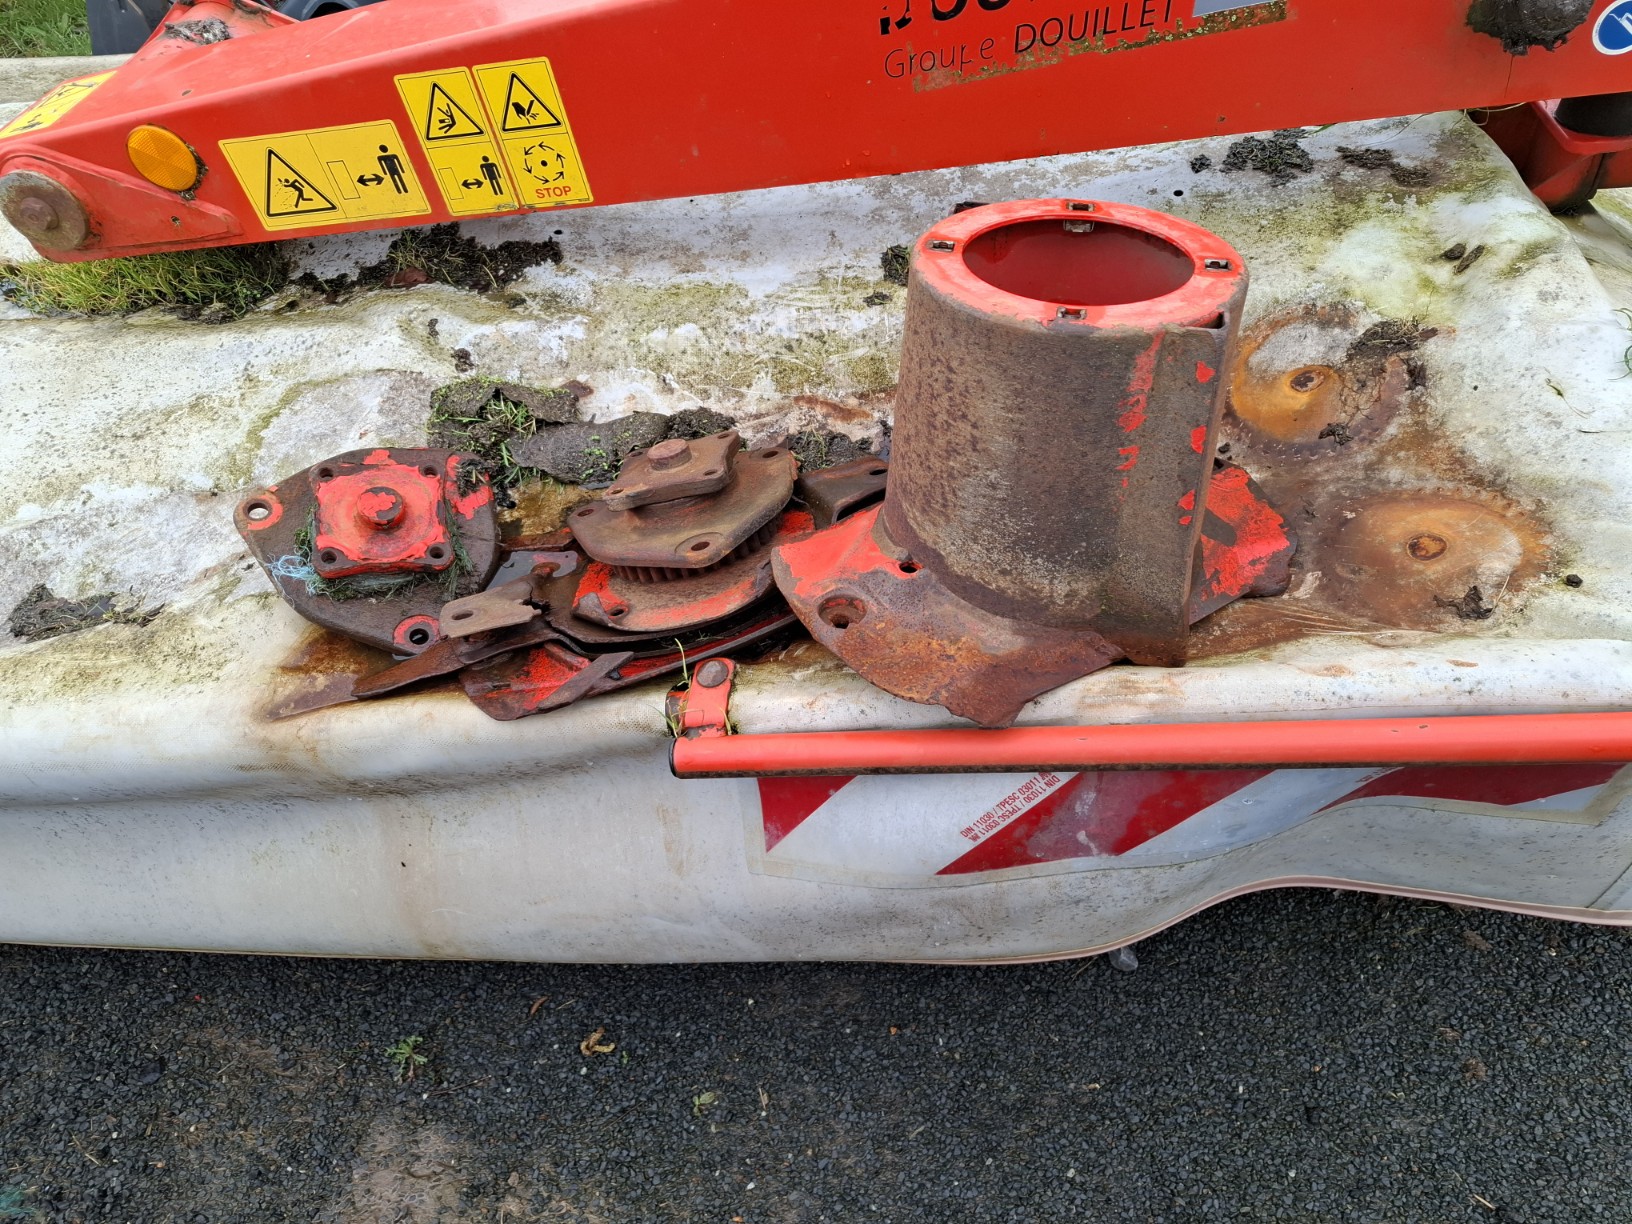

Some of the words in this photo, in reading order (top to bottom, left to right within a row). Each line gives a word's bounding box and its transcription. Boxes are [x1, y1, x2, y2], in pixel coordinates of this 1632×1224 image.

[535, 185, 572, 199] STOP
[1044, 774, 1061, 789] DIN
[1023, 785, 1047, 804] 11030
[960, 825, 975, 838] DIN
[973, 811, 995, 828] 11030
[996, 792, 1020, 811] TPESC
[1018, 776, 1040, 796] 03011
[998, 804, 1022, 822] TPESC
